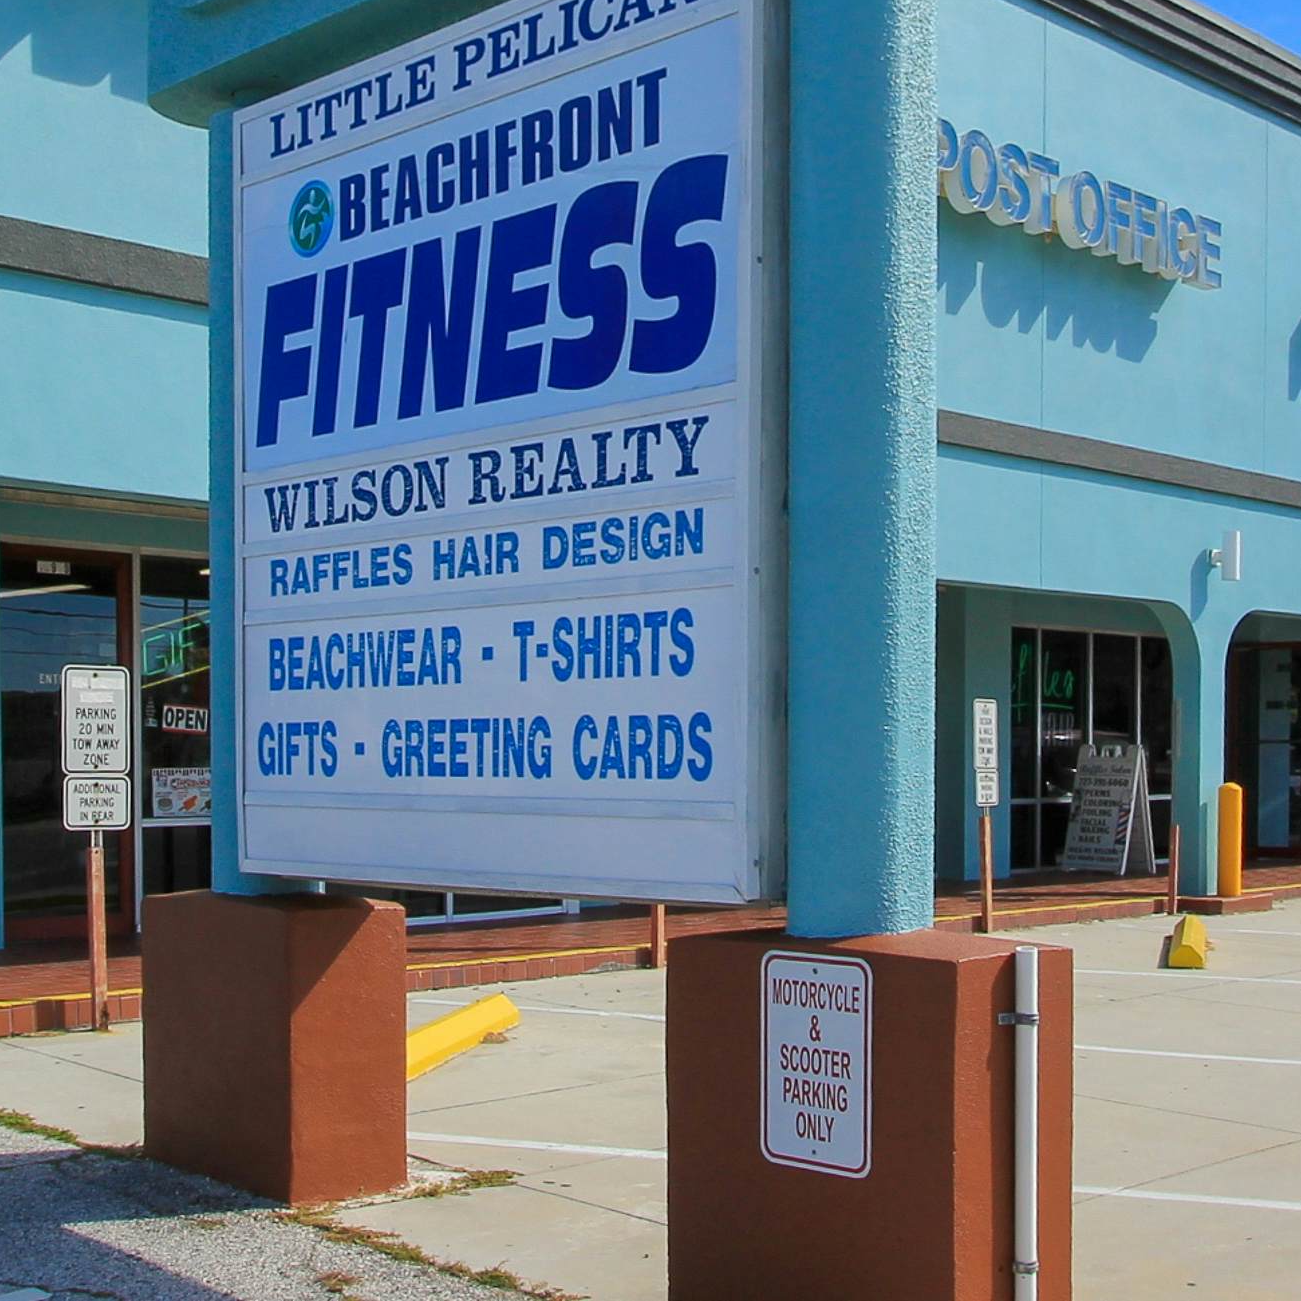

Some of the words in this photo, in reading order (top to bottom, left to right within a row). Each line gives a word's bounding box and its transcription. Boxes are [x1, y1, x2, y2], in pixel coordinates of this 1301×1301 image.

[269, 55, 436, 159] LITTLE
[339, 66, 668, 242] BEACHFRONT
[1057, 171, 1222, 289] OFFICE
[255, 153, 730, 448] FITNESS
[264, 456, 449, 533] WILSON
[467, 415, 710, 505] REALTY
[270, 543, 413, 597] RAFFLES
[432, 531, 520, 581] HAIR
[542, 507, 705, 570] DESIGN
[142, 620, 211, 677] GIF
[268, 625, 462, 692] BEACHWEAR
[512, 607, 695, 684] T-SHIRTS
[75, 708, 117, 720] PARKING
[79, 724, 92, 735] 20
[97, 724, 114, 735] MIN
[164, 707, 207, 731] OPEN
[72, 739, 93, 750] TOW
[96, 739, 120, 750] AWAY
[83, 754, 110, 766] ZONE
[257, 720, 338, 777] GIFTS
[380, 714, 552, 779] GREETING
[572, 711, 714, 782] CARDS
[73, 783, 120, 794] ADDITIONAL
[80, 797, 115, 807] PARKING
[80, 811, 88, 821] IN
[91, 811, 114, 821] REAR
[772, 978, 860, 1013] MOTORCYCLE
[809, 1015, 821, 1042] &
[780, 1044, 852, 1080] SCOOTER
[783, 1077, 848, 1112] PARKING
[796, 1112, 835, 1143] ONLY
